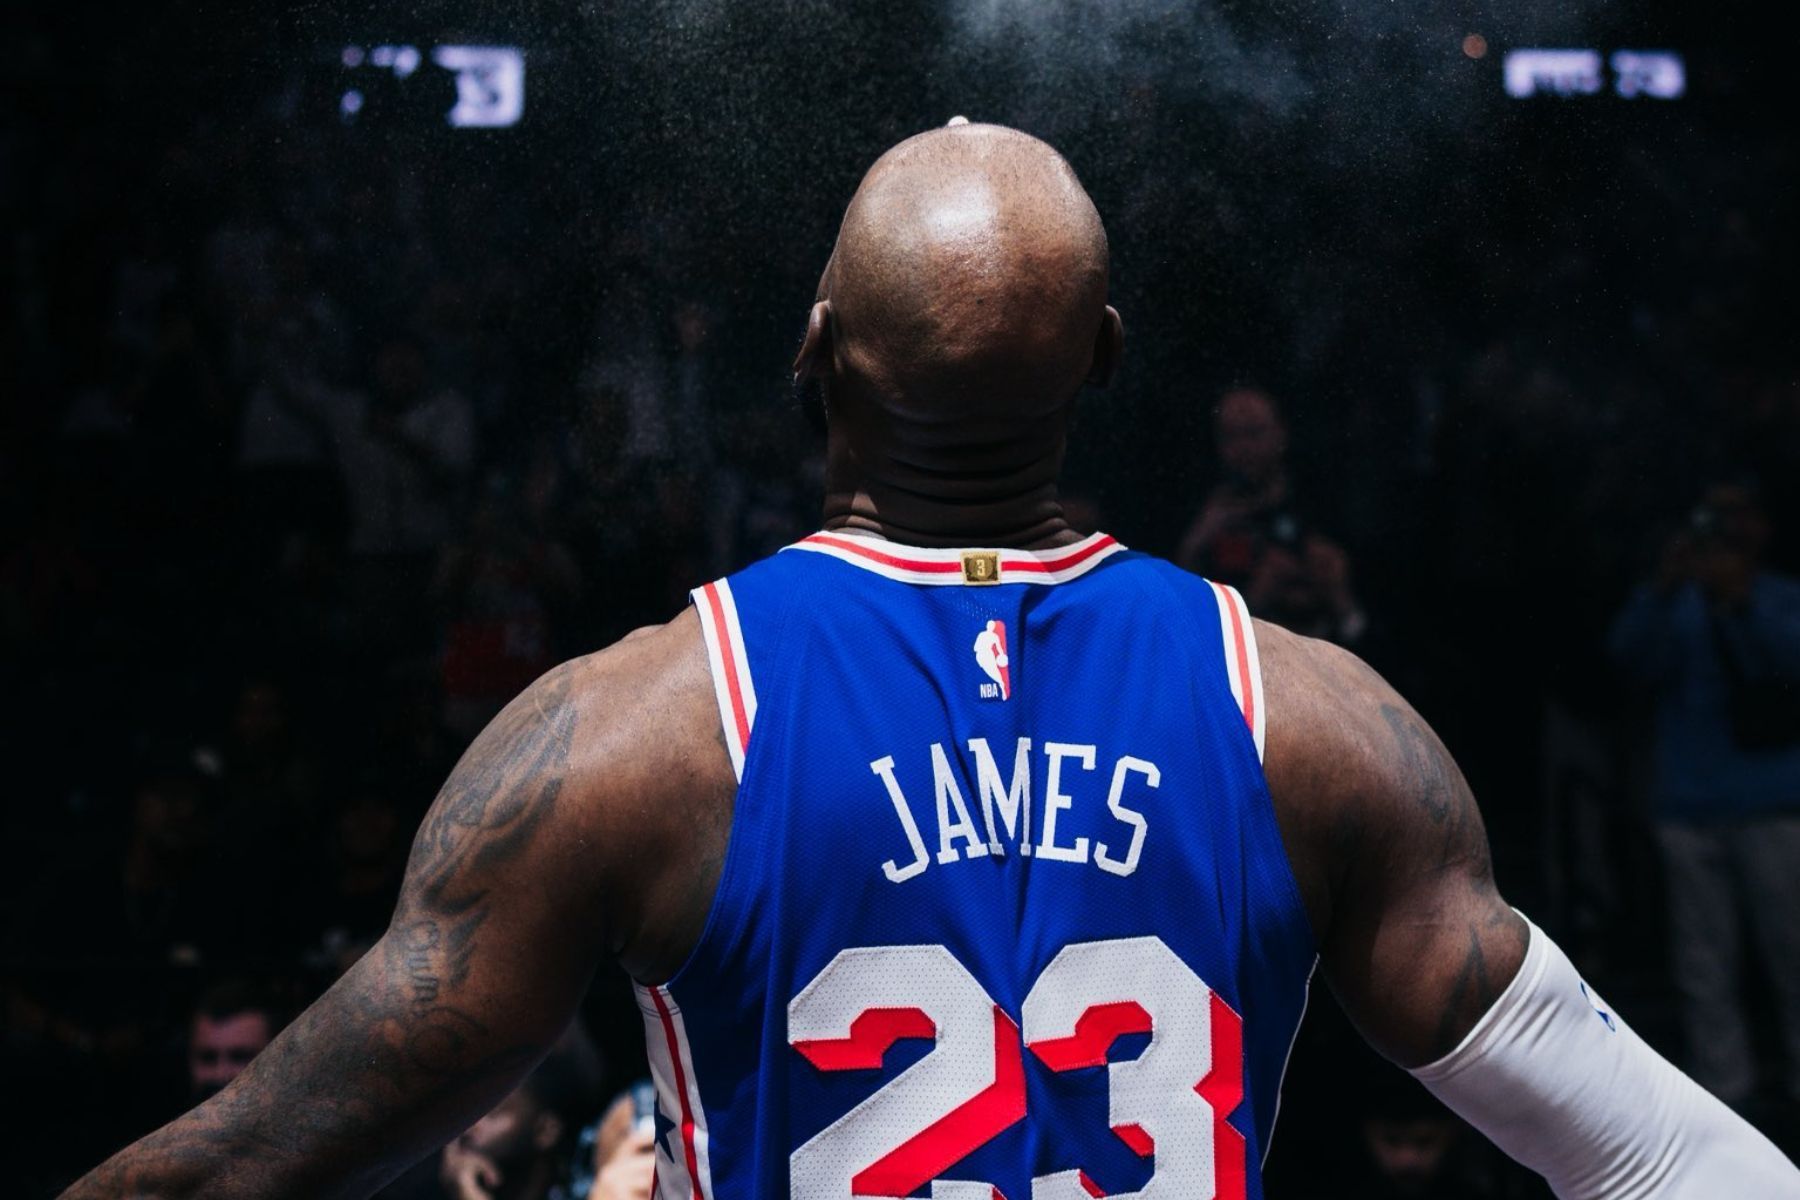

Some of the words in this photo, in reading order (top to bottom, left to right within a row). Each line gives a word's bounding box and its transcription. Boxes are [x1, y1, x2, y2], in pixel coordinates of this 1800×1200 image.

[976, 559, 986, 576] 3
[980, 683, 999, 699] NBA
[870, 737, 1161, 884] JAMES
[787, 935, 1247, 1200] 23
